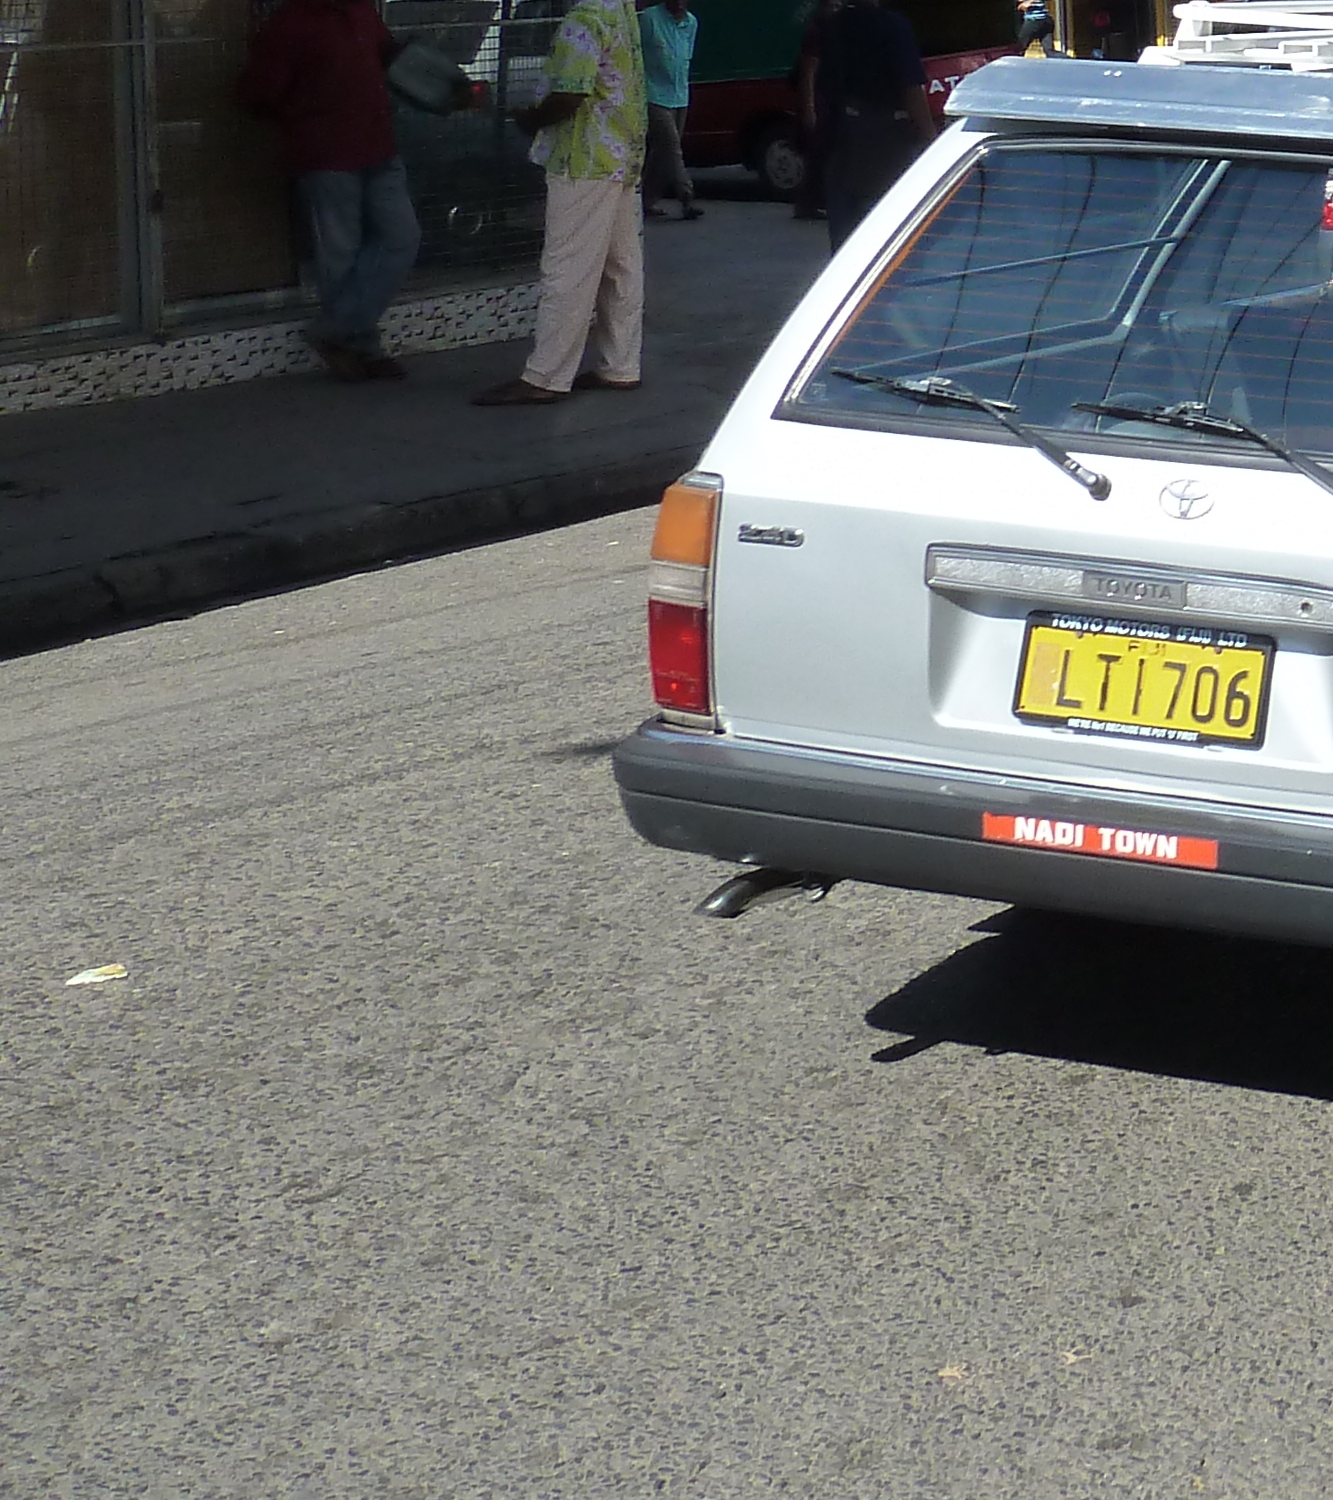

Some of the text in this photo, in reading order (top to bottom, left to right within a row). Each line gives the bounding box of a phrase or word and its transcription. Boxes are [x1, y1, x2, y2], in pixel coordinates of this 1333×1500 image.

[1096, 577, 1173, 601] TOYOTA
[1051, 612, 1104, 632] TOKYO
[1104, 619, 1171, 641] MOTORS
[1216, 631, 1248, 649] LTD
[1127, 640, 1167, 657] FIJI
[1054, 648, 1252, 729] LT1706
[1013, 816, 1179, 860] NADI TOWN
